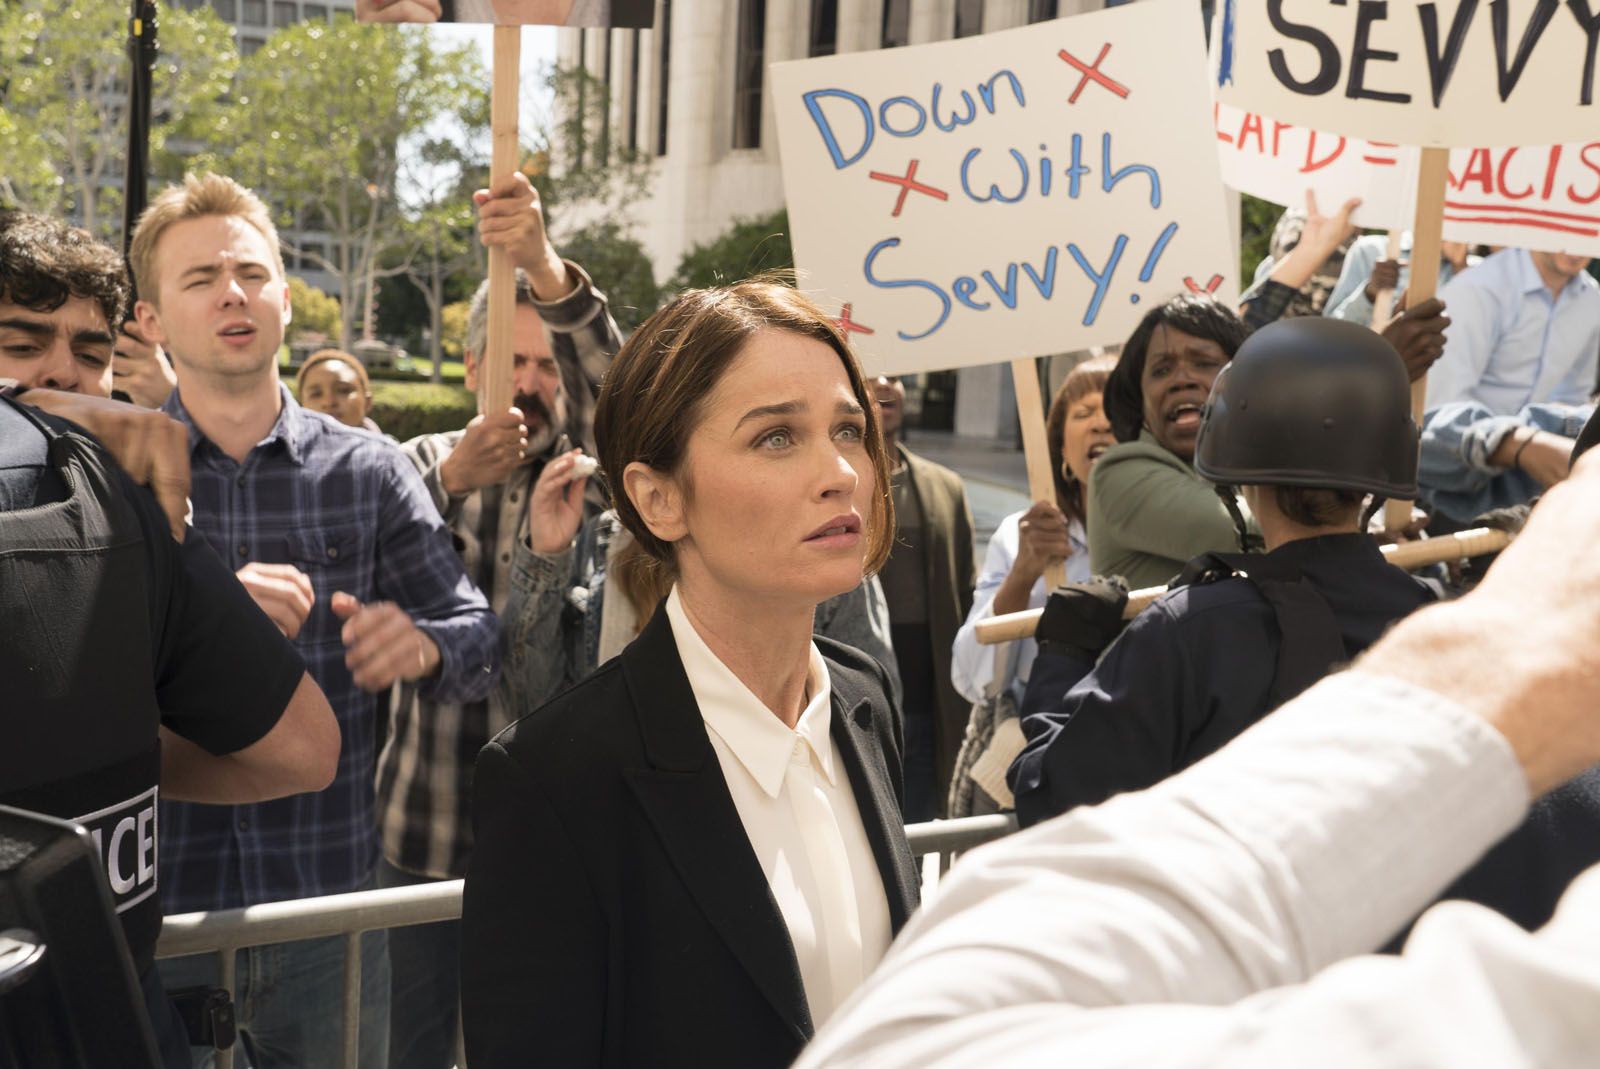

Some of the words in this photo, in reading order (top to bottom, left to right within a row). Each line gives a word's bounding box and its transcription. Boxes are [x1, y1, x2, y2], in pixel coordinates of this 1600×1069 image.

[1266, 0, 1600, 108] SEVVY
[803, 69, 1026, 170] Down
[961, 132, 1161, 209] With
[1447, 142, 1600, 205] ACIS
[91, 806, 154, 895] CE
